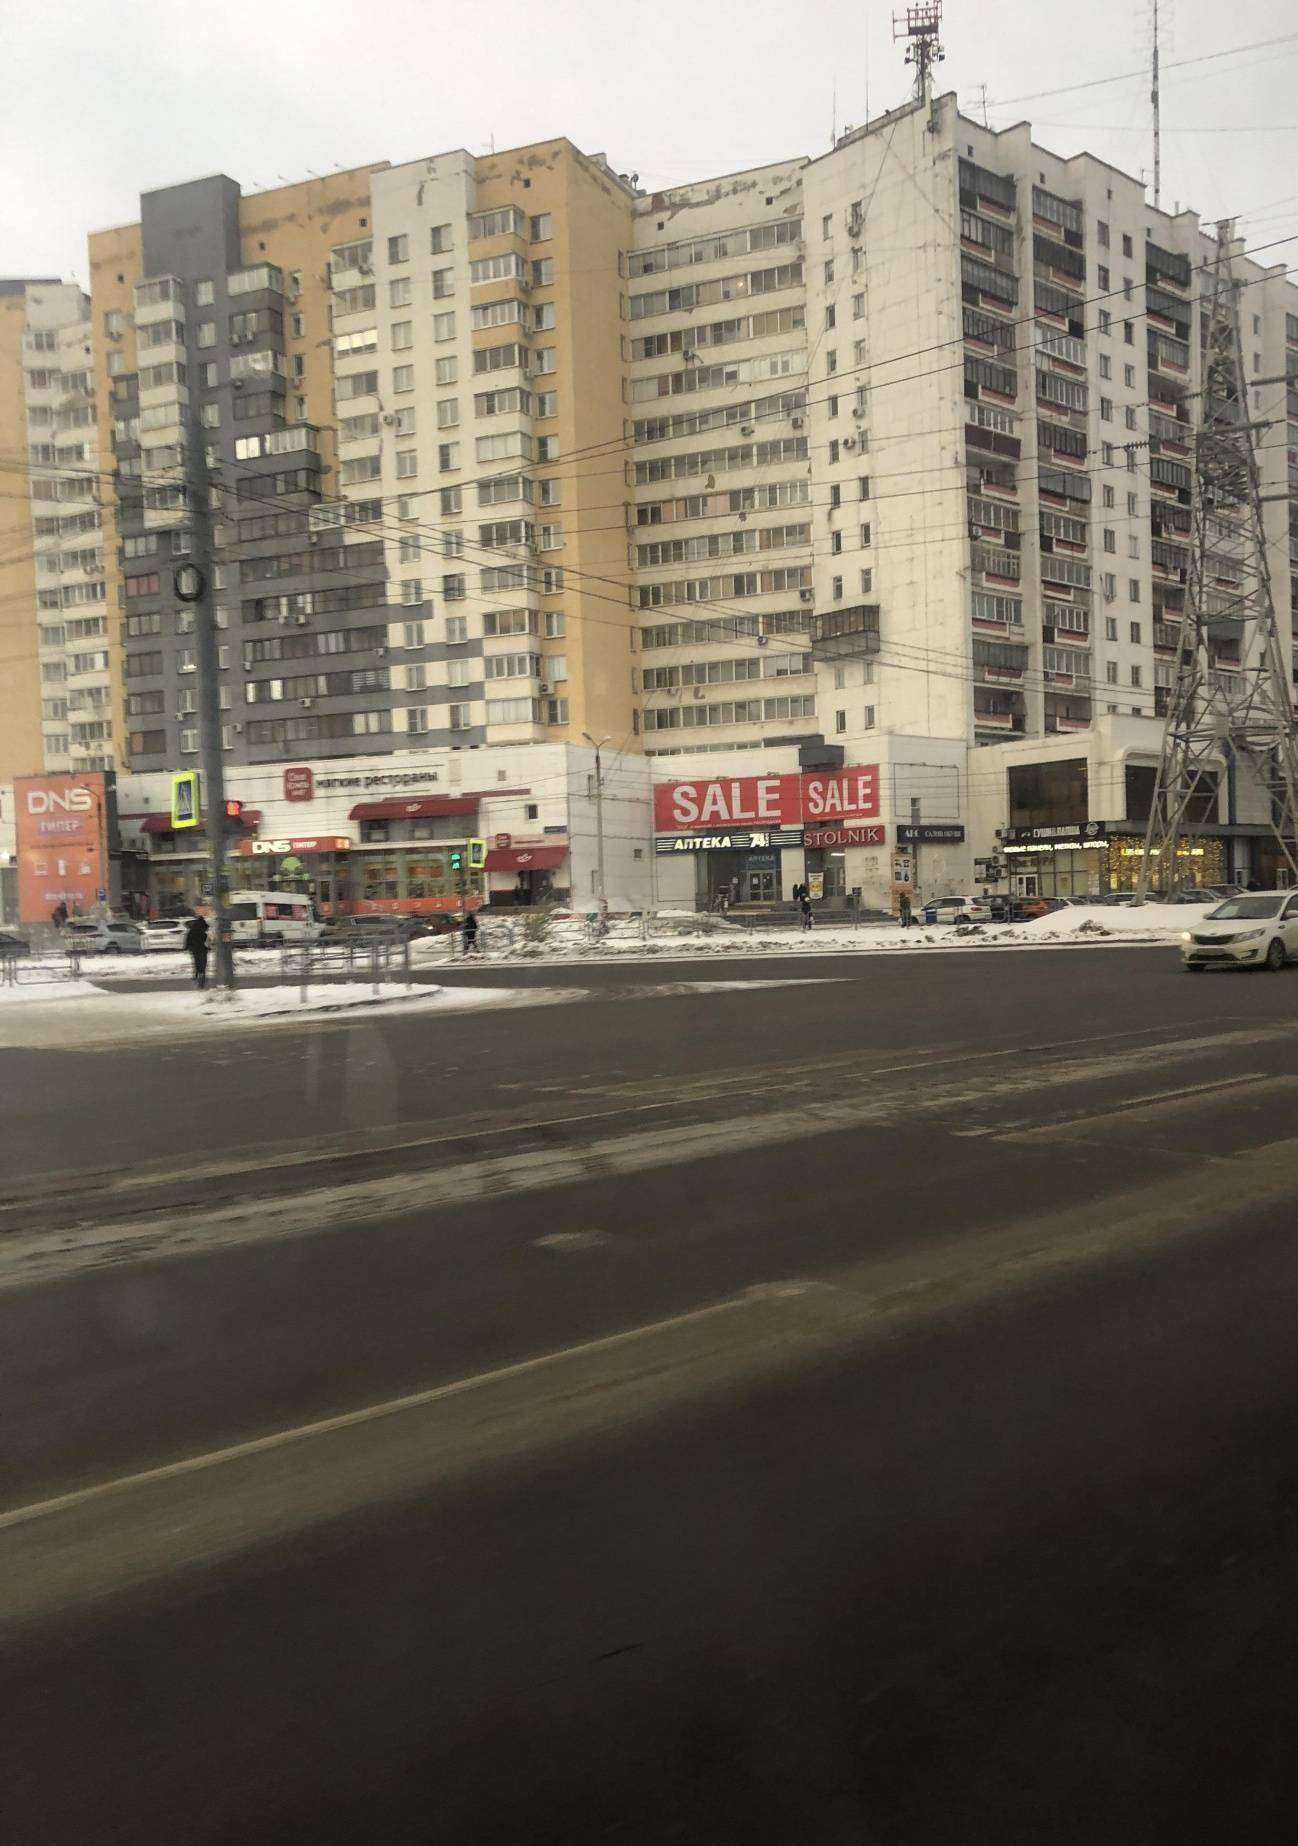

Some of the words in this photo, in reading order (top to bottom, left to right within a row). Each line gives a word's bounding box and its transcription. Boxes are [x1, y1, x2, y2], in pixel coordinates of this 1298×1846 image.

[363, 772, 438, 789] рестораны
[27, 788, 91, 814] DNS
[672, 780, 781, 822] SALE
[808, 775, 872, 815] SALE
[252, 840, 291, 853] DNS
[674, 832, 732, 850] АПТЕКА
[803, 828, 879, 847] STOLNIK
